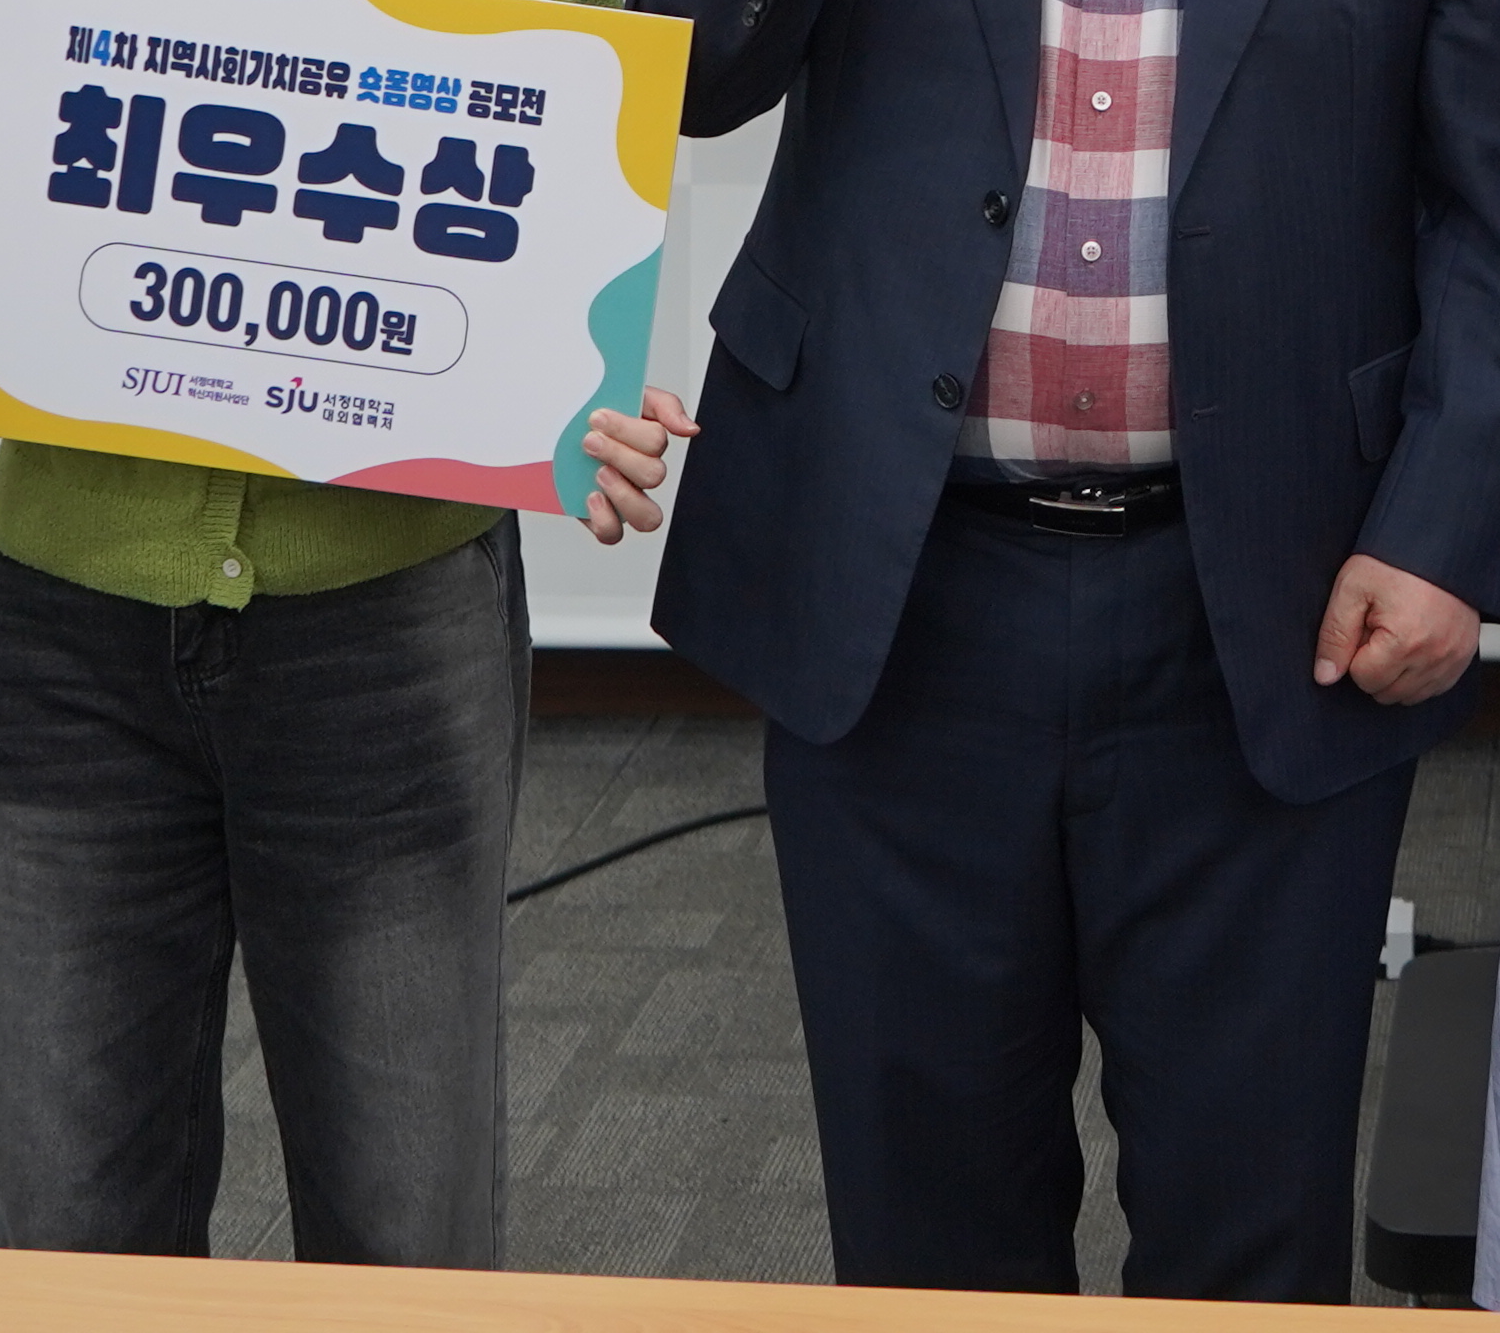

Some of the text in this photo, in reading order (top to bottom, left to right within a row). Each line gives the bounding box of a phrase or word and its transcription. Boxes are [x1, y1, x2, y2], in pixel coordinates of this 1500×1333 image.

[65, 25, 547, 127] 제4차 지역사회가치공유 숏폼영상 공모전
[46, 83, 536, 265] 최우수상
[128, 259, 417, 358] 300,000원
[121, 367, 185, 398] SJUI
[322, 392, 396, 416] 서정대학교
[322, 408, 394, 432] 대외협력처
